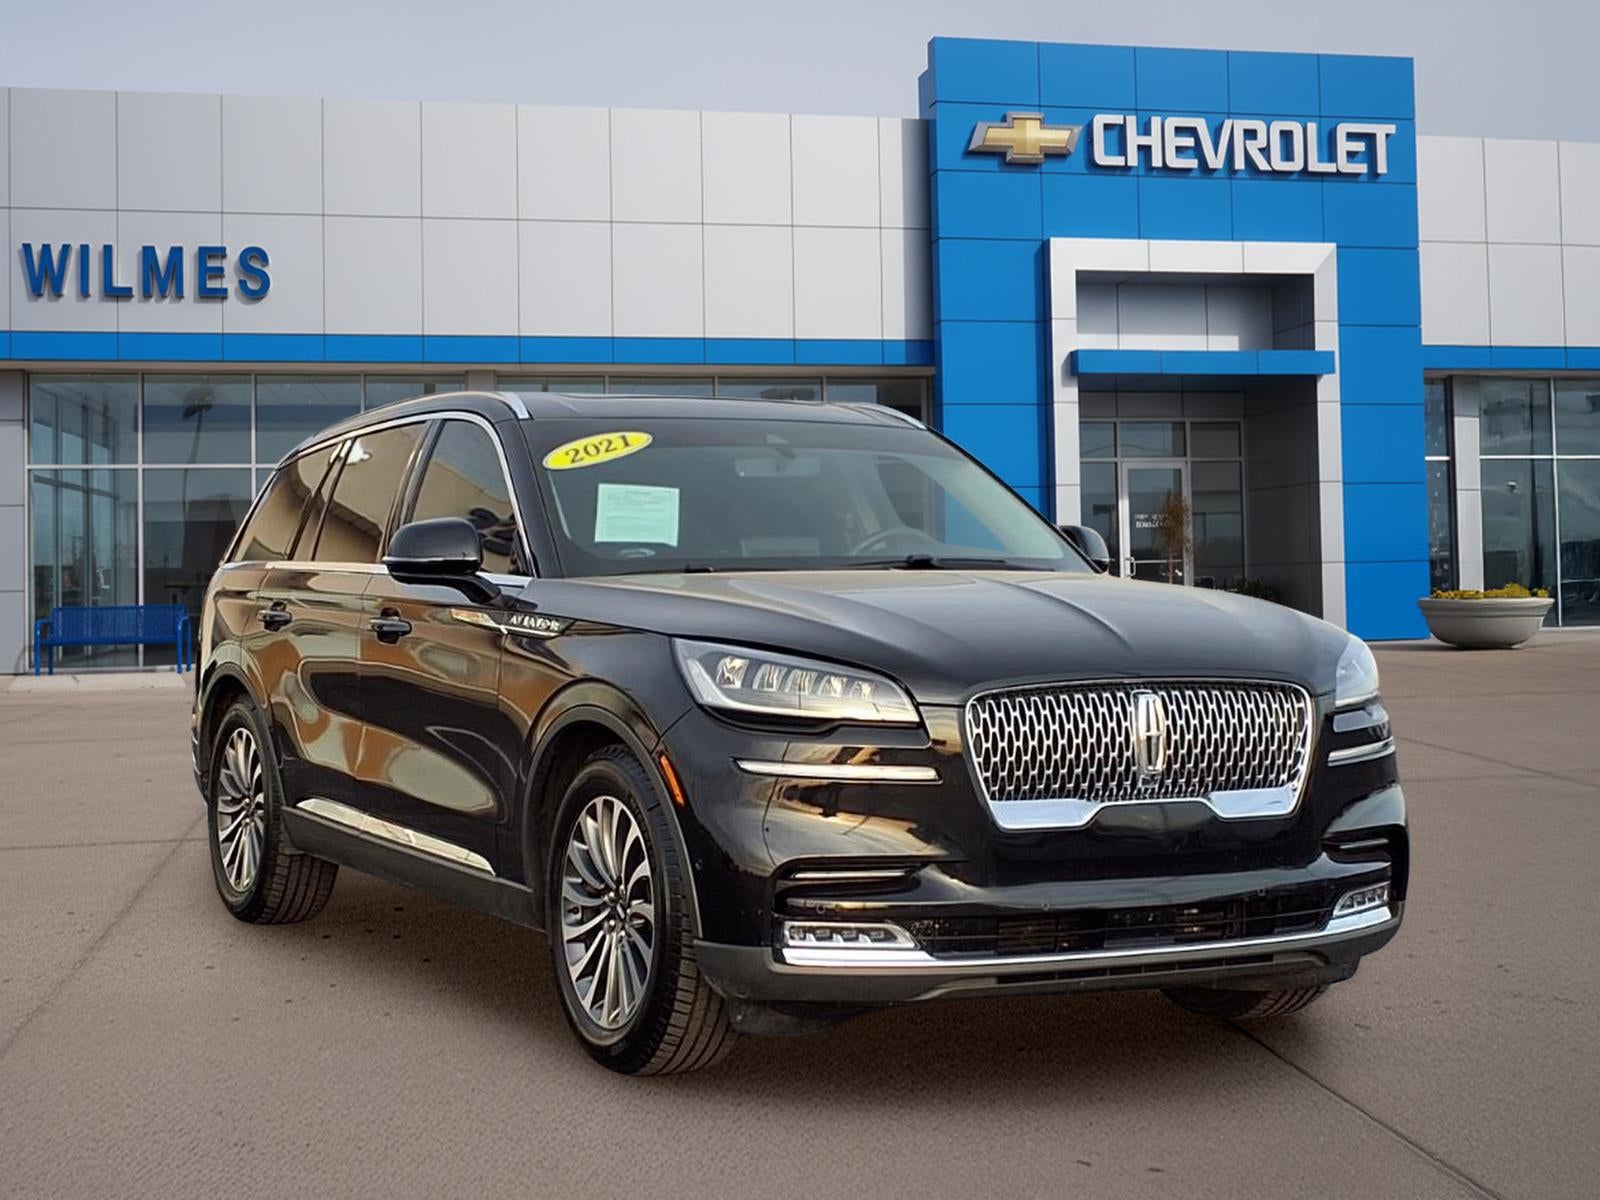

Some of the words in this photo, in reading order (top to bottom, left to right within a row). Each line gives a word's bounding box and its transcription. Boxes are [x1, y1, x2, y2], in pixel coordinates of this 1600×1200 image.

[1093, 114, 1396, 174] CHEVROLET
[22, 243, 271, 300] WILMES
[565, 435, 632, 464] 2021
